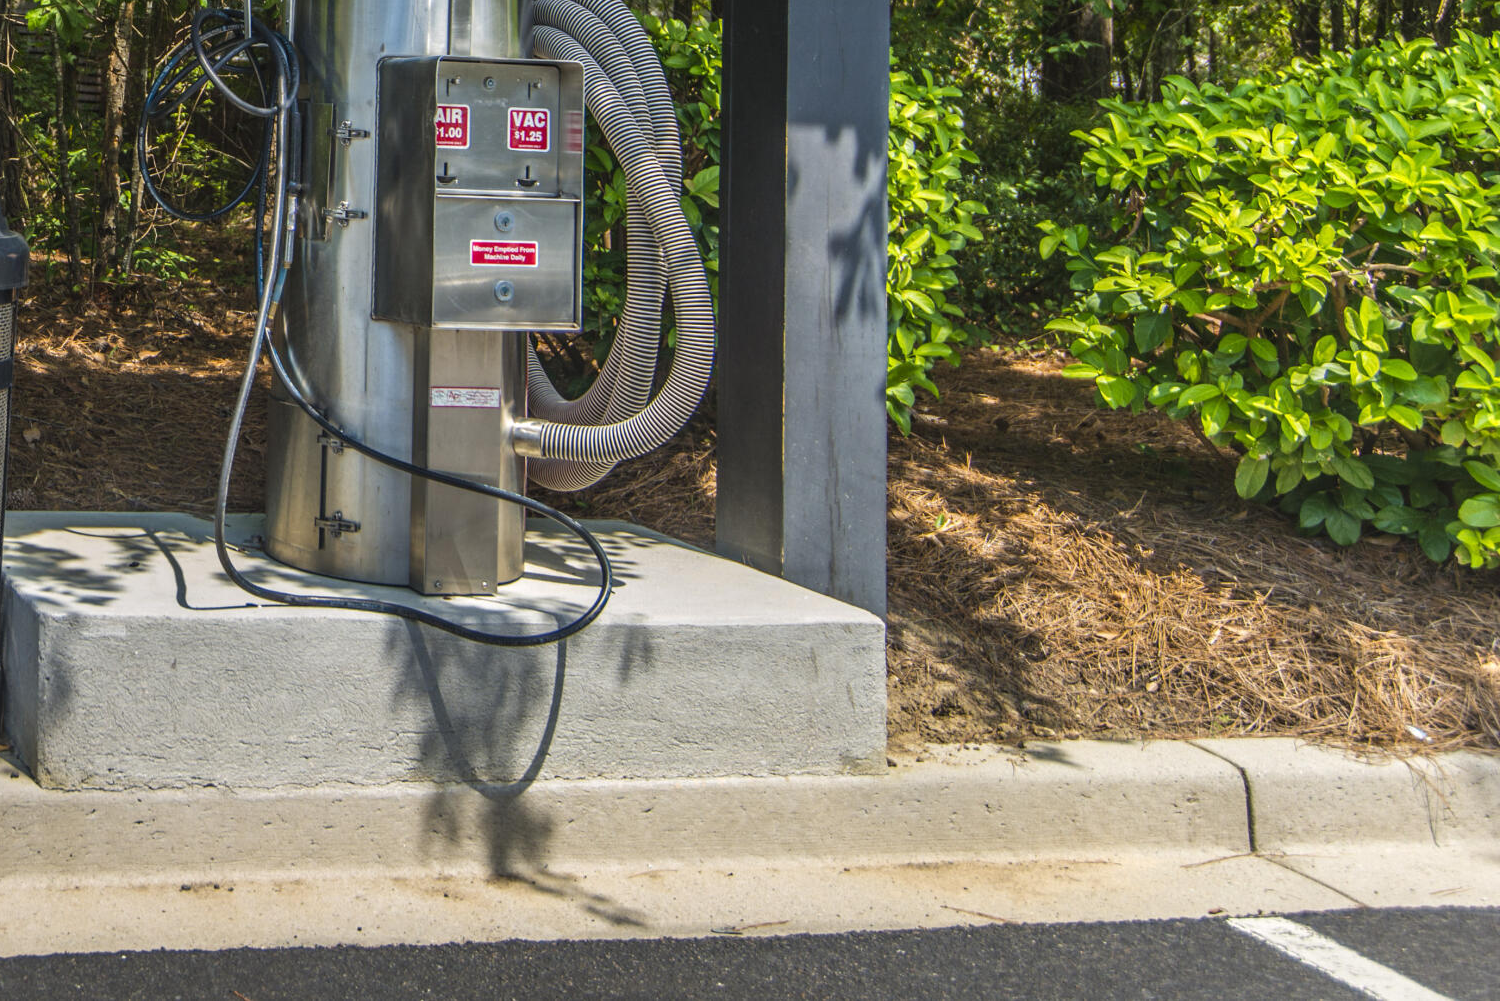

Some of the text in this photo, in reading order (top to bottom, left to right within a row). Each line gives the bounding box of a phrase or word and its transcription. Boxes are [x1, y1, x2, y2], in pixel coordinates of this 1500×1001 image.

[436, 107, 462, 124] AIR
[512, 112, 546, 128] VAC
[514, 130, 543, 142] $1.25
[472, 245, 535, 254] Money Emptied From
[484, 253, 526, 262] Machine Daily
